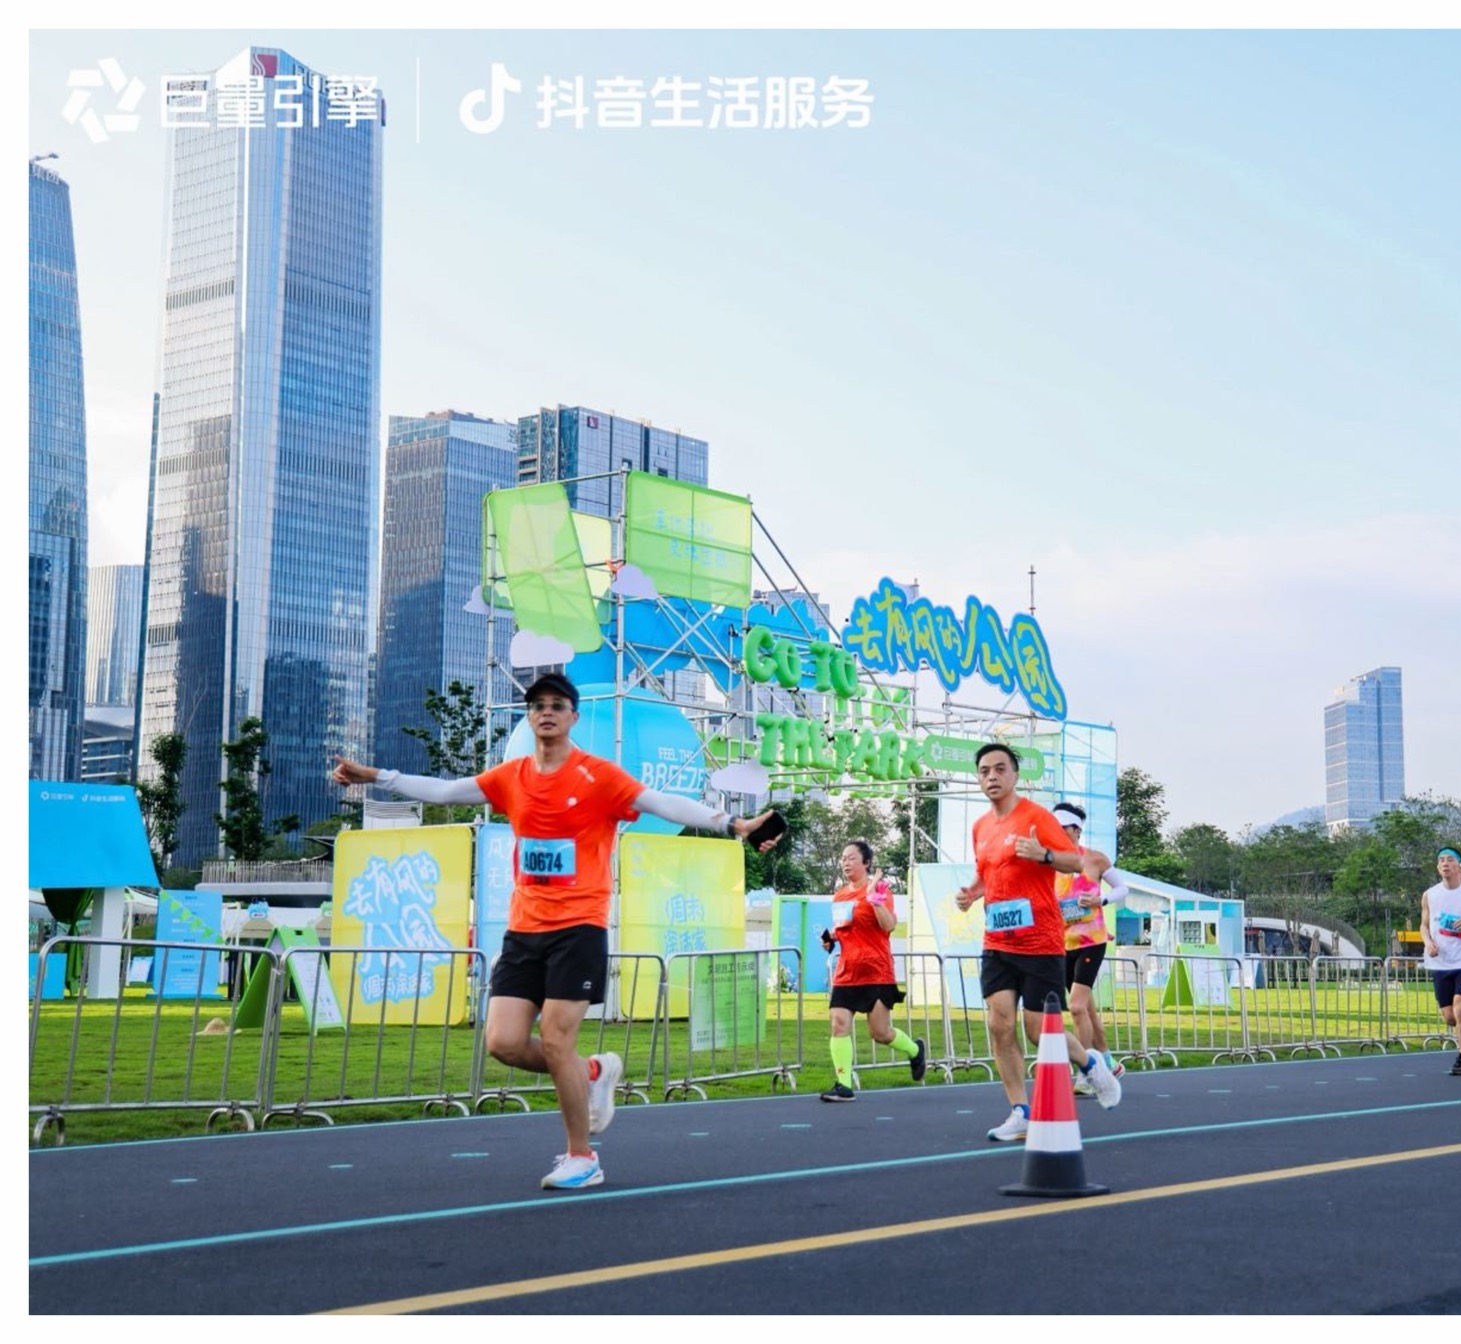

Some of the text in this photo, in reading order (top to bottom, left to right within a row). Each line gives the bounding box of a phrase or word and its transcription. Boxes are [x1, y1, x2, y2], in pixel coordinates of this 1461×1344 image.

[743, 626, 859, 699] GO TO
[757, 713, 925, 781] THE PARK
[523, 851, 563, 872] A0674
[993, 909, 1023, 928] A0527
